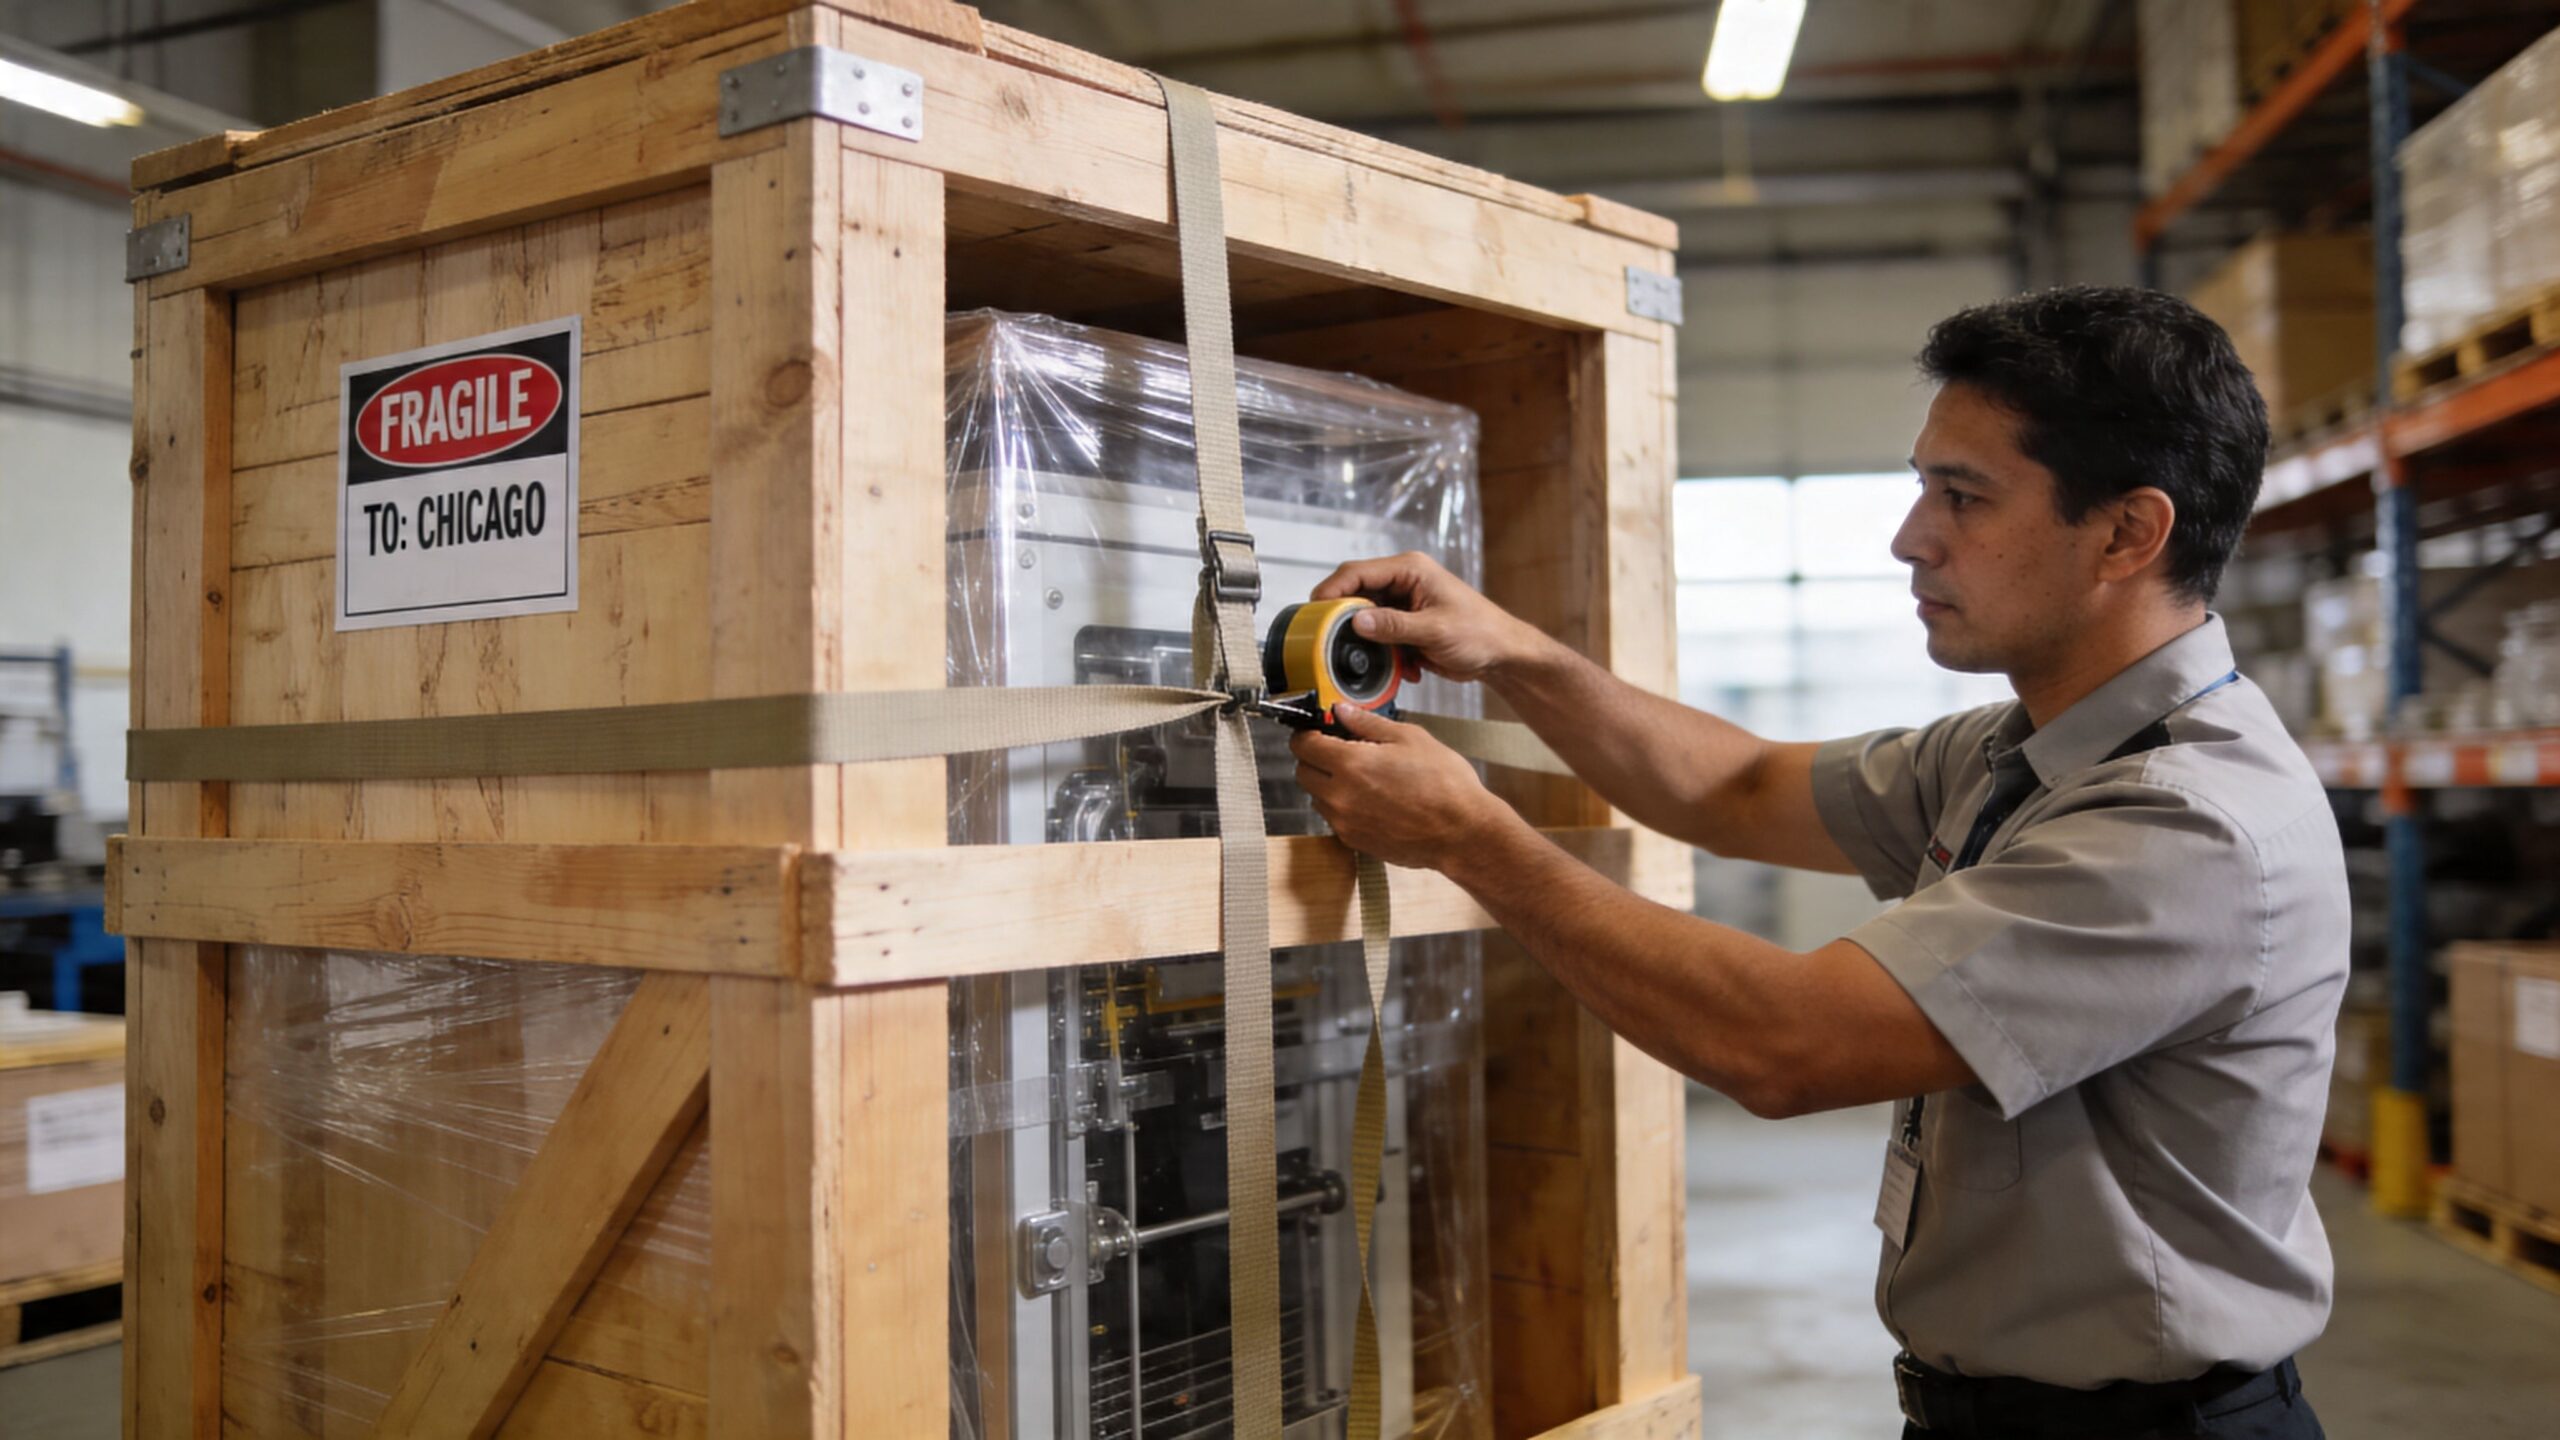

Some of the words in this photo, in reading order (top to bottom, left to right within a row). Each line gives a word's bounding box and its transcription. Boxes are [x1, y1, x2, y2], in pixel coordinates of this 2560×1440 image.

[380, 368, 532, 453] FRAGILE
[363, 502, 407, 556] TO:
[417, 481, 546, 550] CHICAGO
